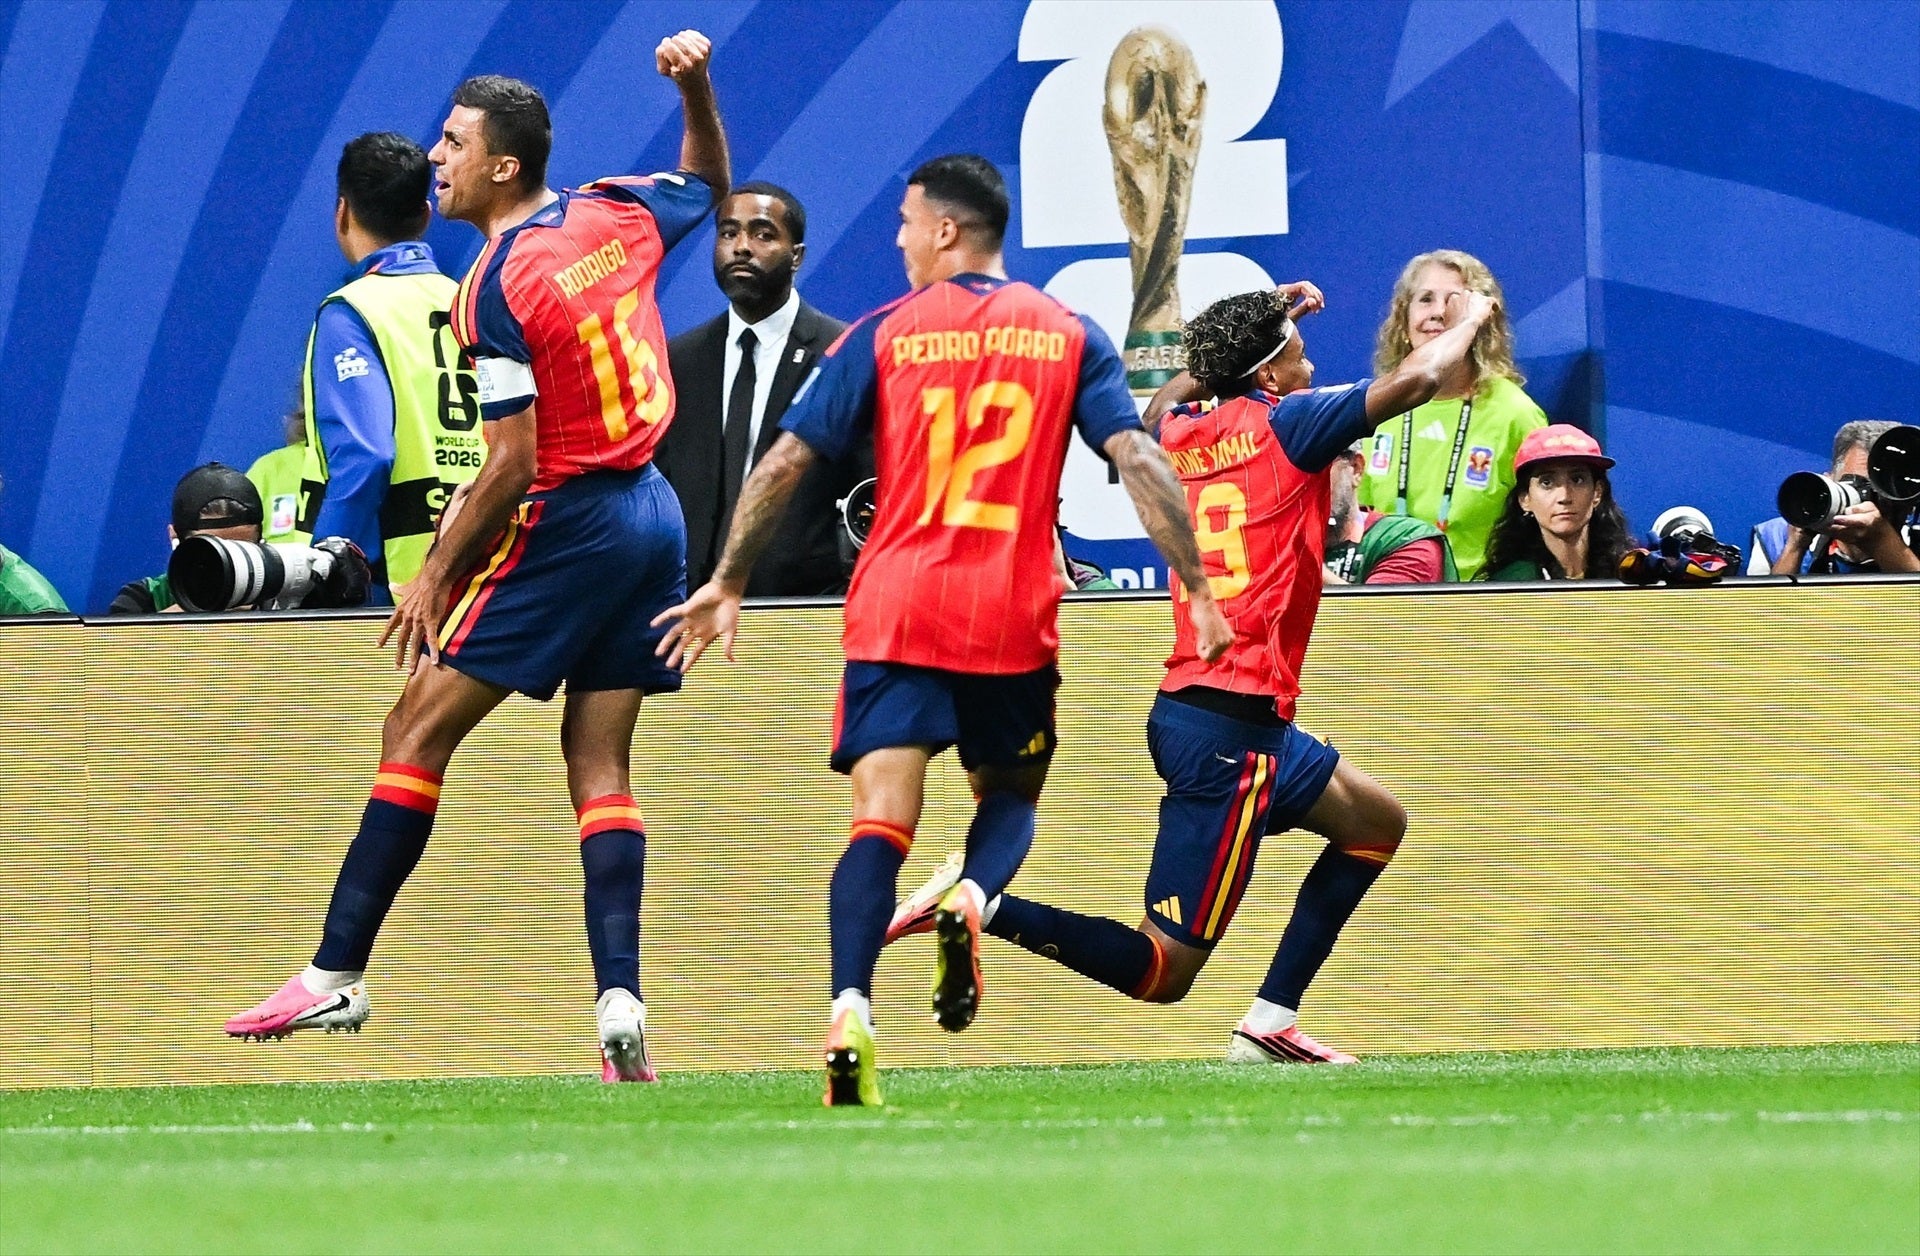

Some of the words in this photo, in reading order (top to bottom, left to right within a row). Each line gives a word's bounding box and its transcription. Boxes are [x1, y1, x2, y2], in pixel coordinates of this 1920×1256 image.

[553, 238, 628, 300] RODRIGO
[576, 285, 670, 443] 16
[892, 330, 980, 367] PEDRO
[984, 326, 1066, 362] PORRO
[435, 435, 464, 447] WORLD
[466, 438, 480, 448] CUP
[435, 449, 481, 468] 2026
[917, 380, 1034, 533] 12
[1204, 431, 1261, 471] YAMAL
